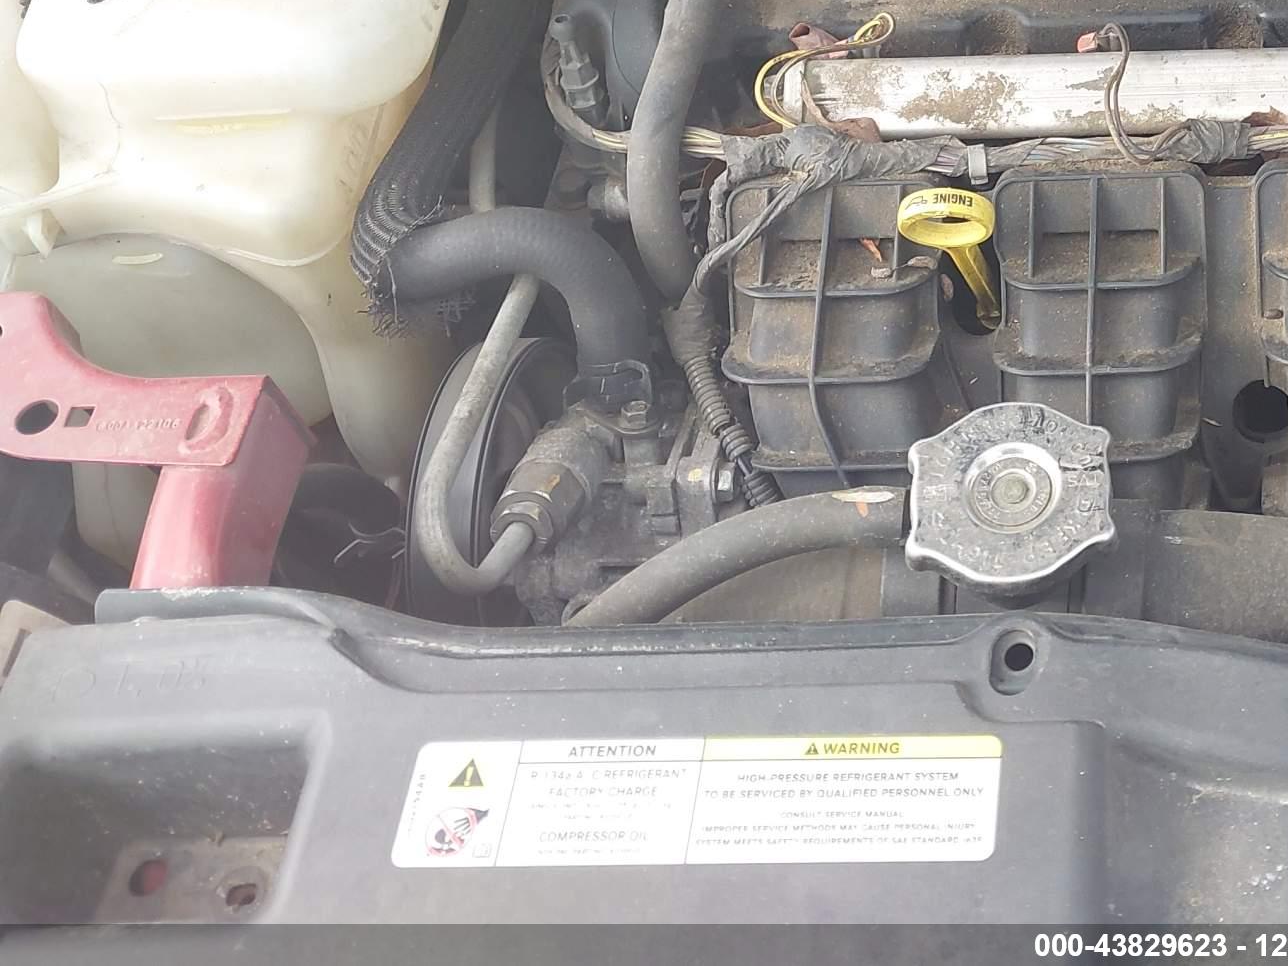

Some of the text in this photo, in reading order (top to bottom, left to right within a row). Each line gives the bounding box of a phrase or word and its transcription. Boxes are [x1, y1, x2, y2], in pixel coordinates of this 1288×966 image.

[932, 193, 974, 207] ENGINE
[568, 745, 657, 757] ATTENTION
[823, 742, 900, 755] WARNING
[602, 768, 687, 779] REFRIGERANT
[832, 772, 911, 782] REFRIGERANT
[914, 771, 959, 781] SYSTEM
[548, 786, 658, 797] FACTORY CHARGE
[704, 787, 984, 799] TO BE SERVICED BY QUALIFIED PERSONNEL ONLY
[779, 810, 905, 818] CONSULT SERVICE MANUAL
[840, 824, 858, 832] MAY
[862, 824, 891, 832] CAUSE
[893, 824, 941, 832] PERSONAL
[537, 830, 625, 843] COMPRESSOR
